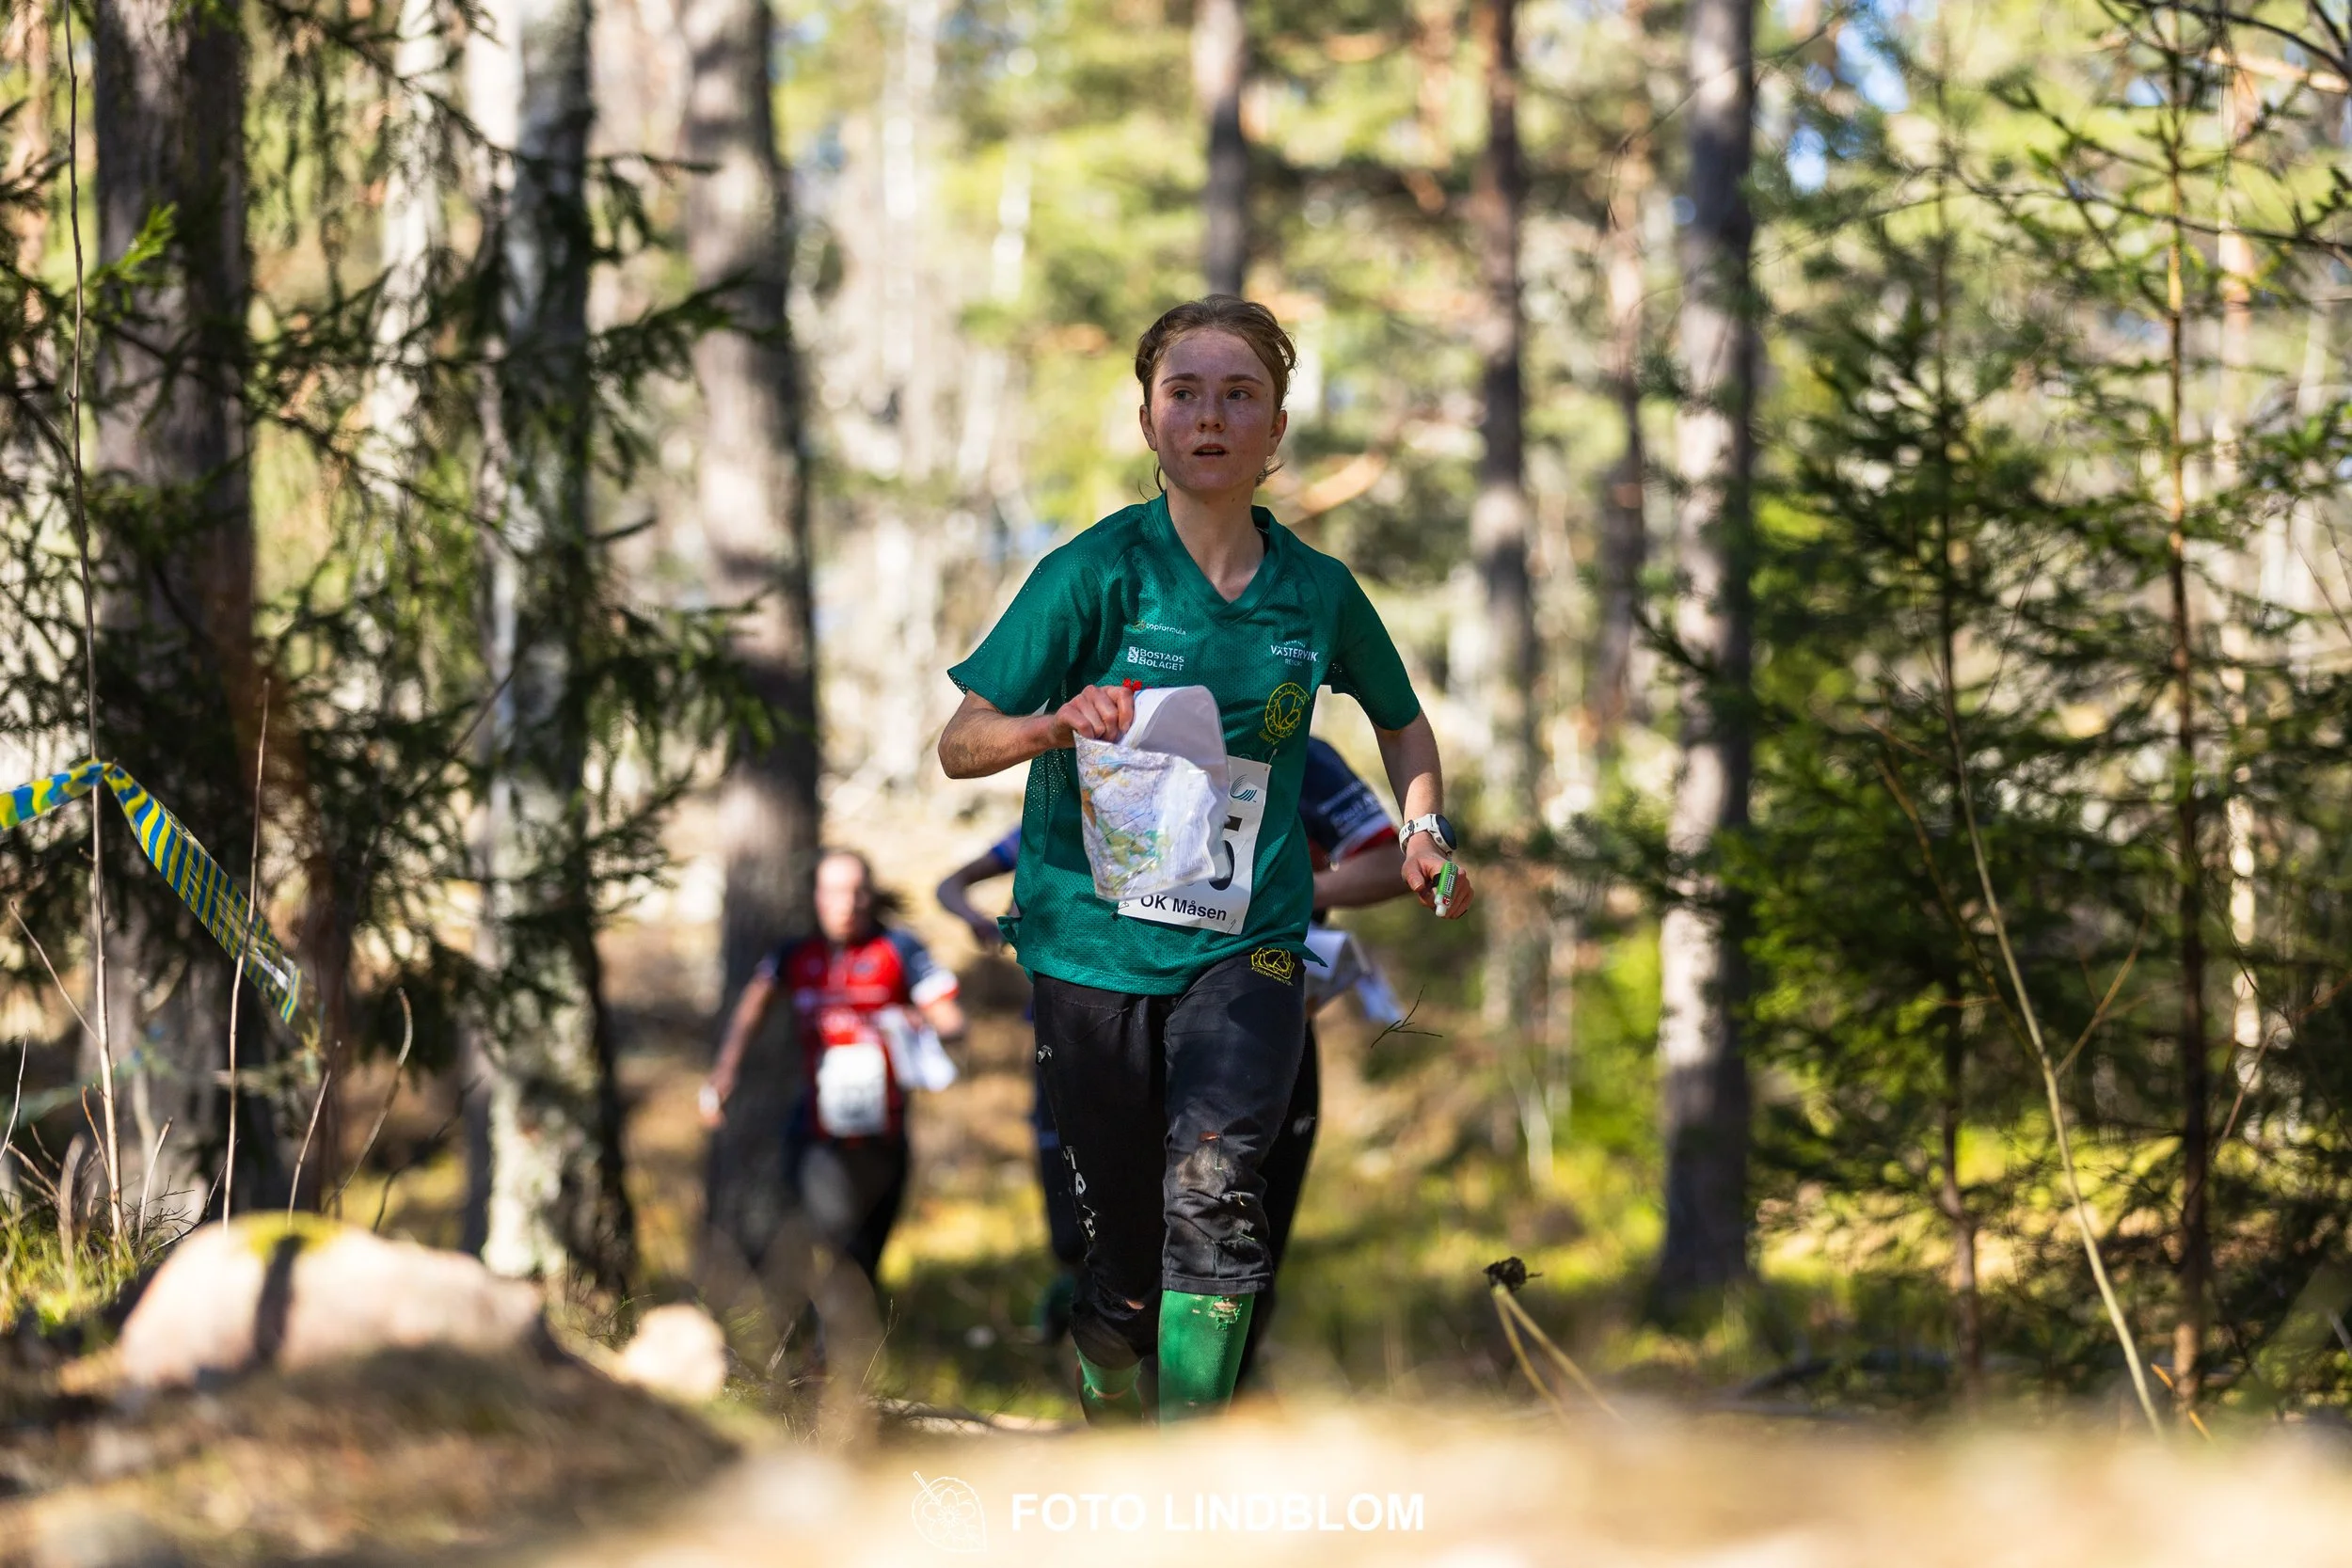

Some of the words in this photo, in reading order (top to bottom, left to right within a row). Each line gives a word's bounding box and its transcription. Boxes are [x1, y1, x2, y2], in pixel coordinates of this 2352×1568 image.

[1270, 644, 1319, 662] VÄSTERVIK
[1138, 657, 1184, 671] BOLAGET
[1140, 895, 1168, 911] OK
[1172, 897, 1227, 921] Måsen
